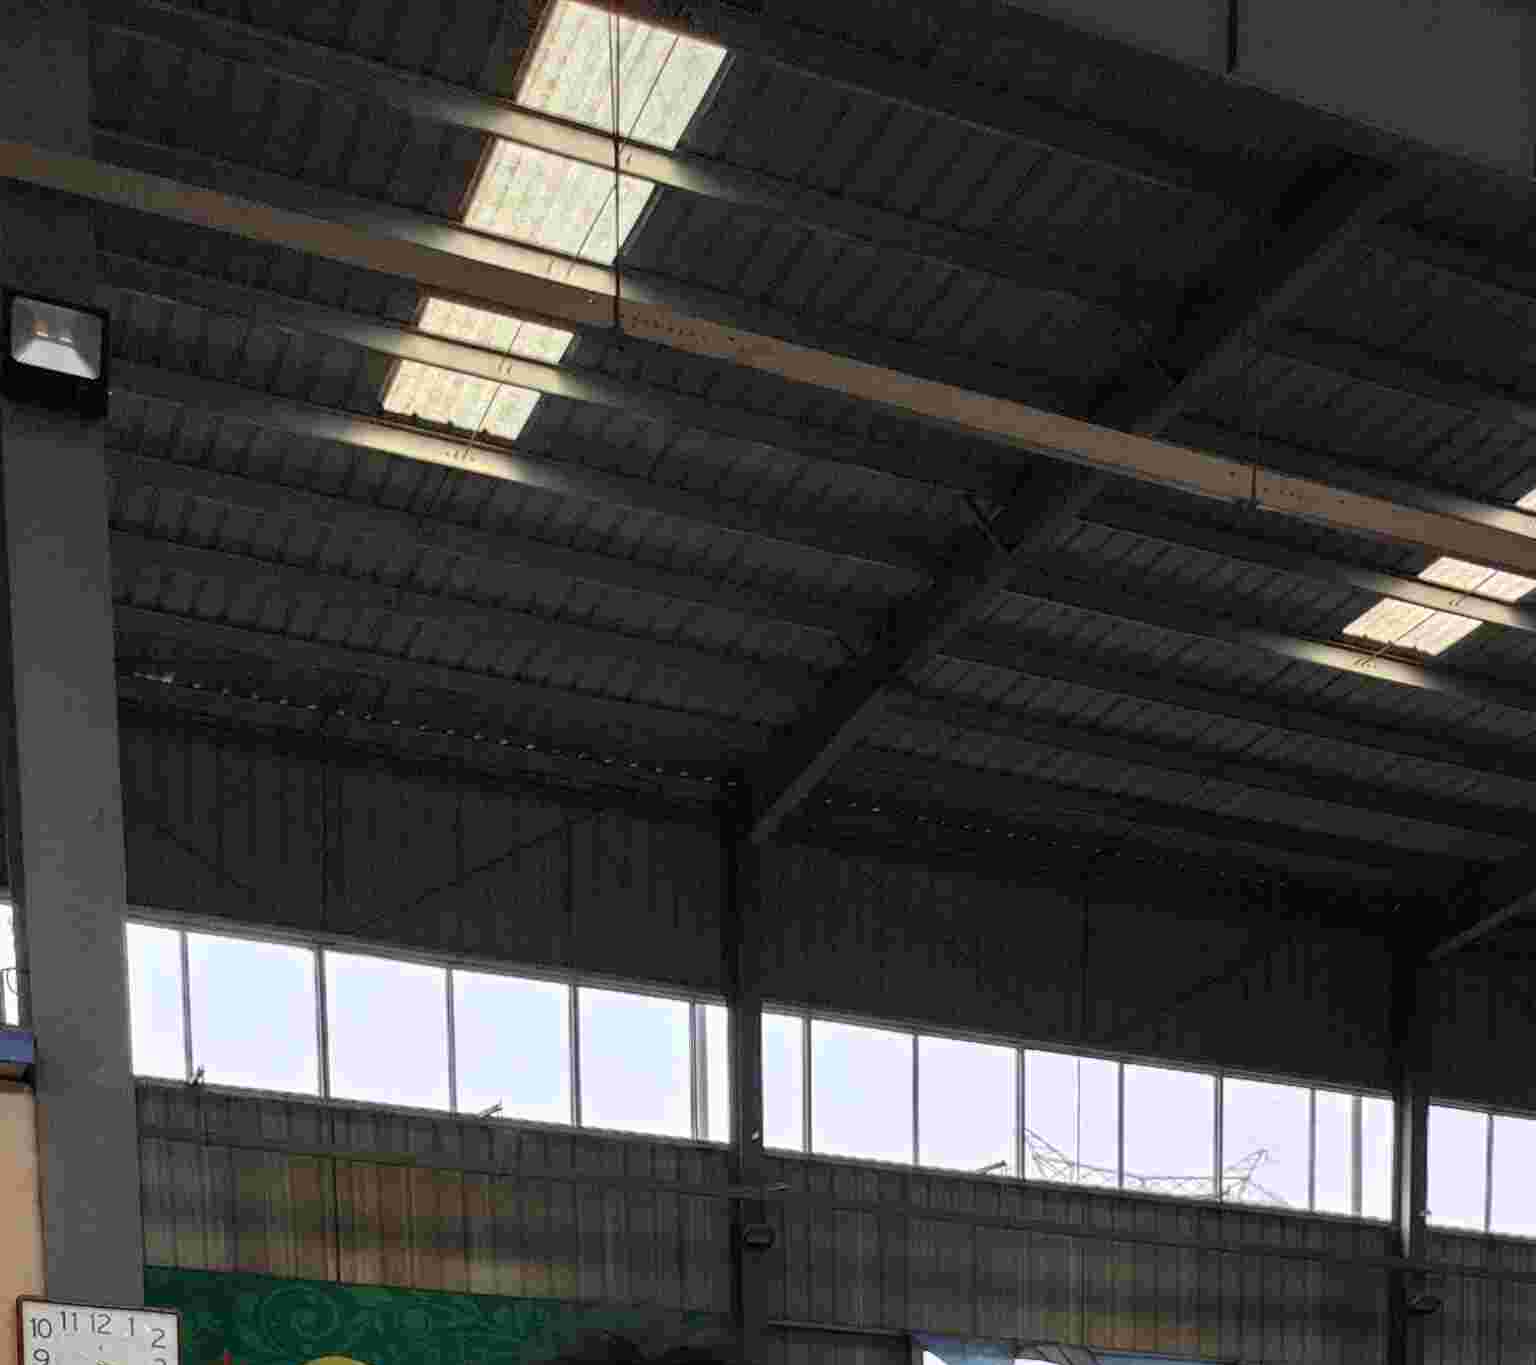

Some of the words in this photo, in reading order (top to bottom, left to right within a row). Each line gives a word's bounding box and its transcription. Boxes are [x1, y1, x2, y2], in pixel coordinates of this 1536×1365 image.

[31, 1317, 53, 1339] 10
[61, 1311, 78, 1332] 11
[90, 1313, 112, 1336] 12
[151, 1328, 166, 1350] 2
